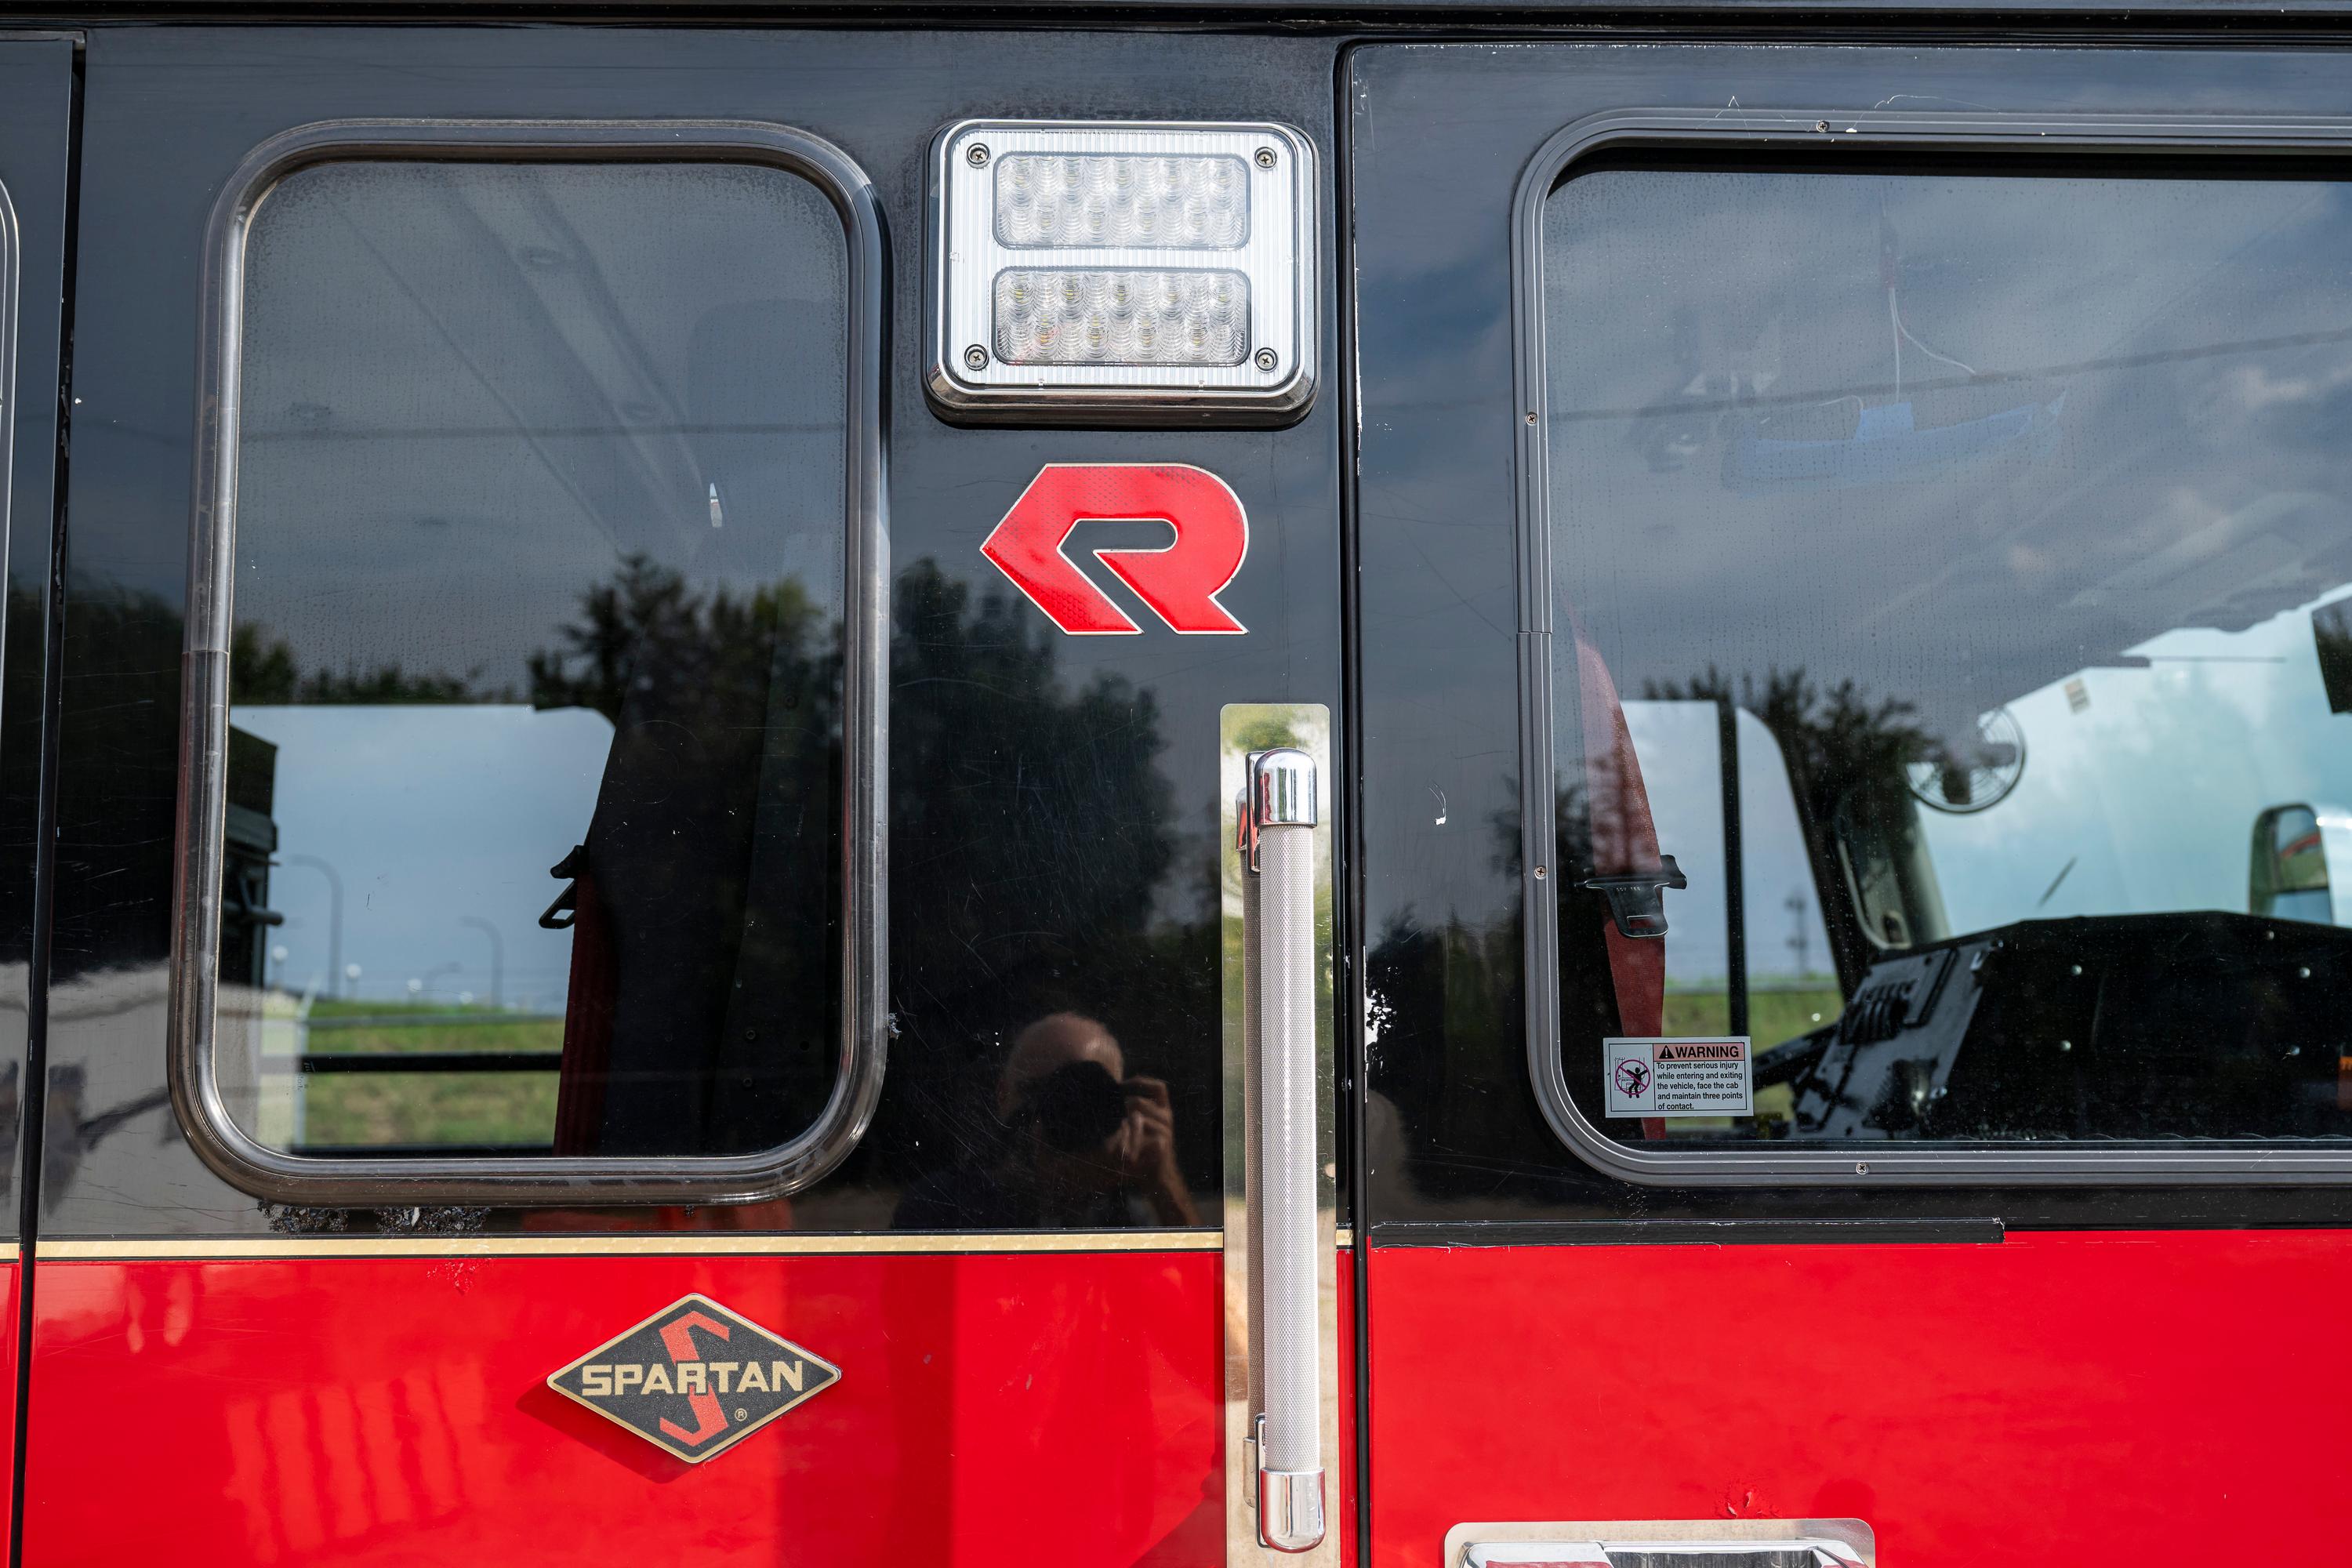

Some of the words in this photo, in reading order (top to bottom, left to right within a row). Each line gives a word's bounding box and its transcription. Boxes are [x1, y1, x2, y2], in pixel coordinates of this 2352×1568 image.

[1675, 1046, 1739, 1058] WARNING
[1719, 1062, 1739, 1070] injury
[1676, 1072, 1704, 1080] entering
[1720, 1071, 1743, 1080] exiting
[1670, 1082, 1696, 1091] vehicle,
[1722, 1091, 1743, 1101] points
[582, 1360, 803, 1396] SPARTAN
